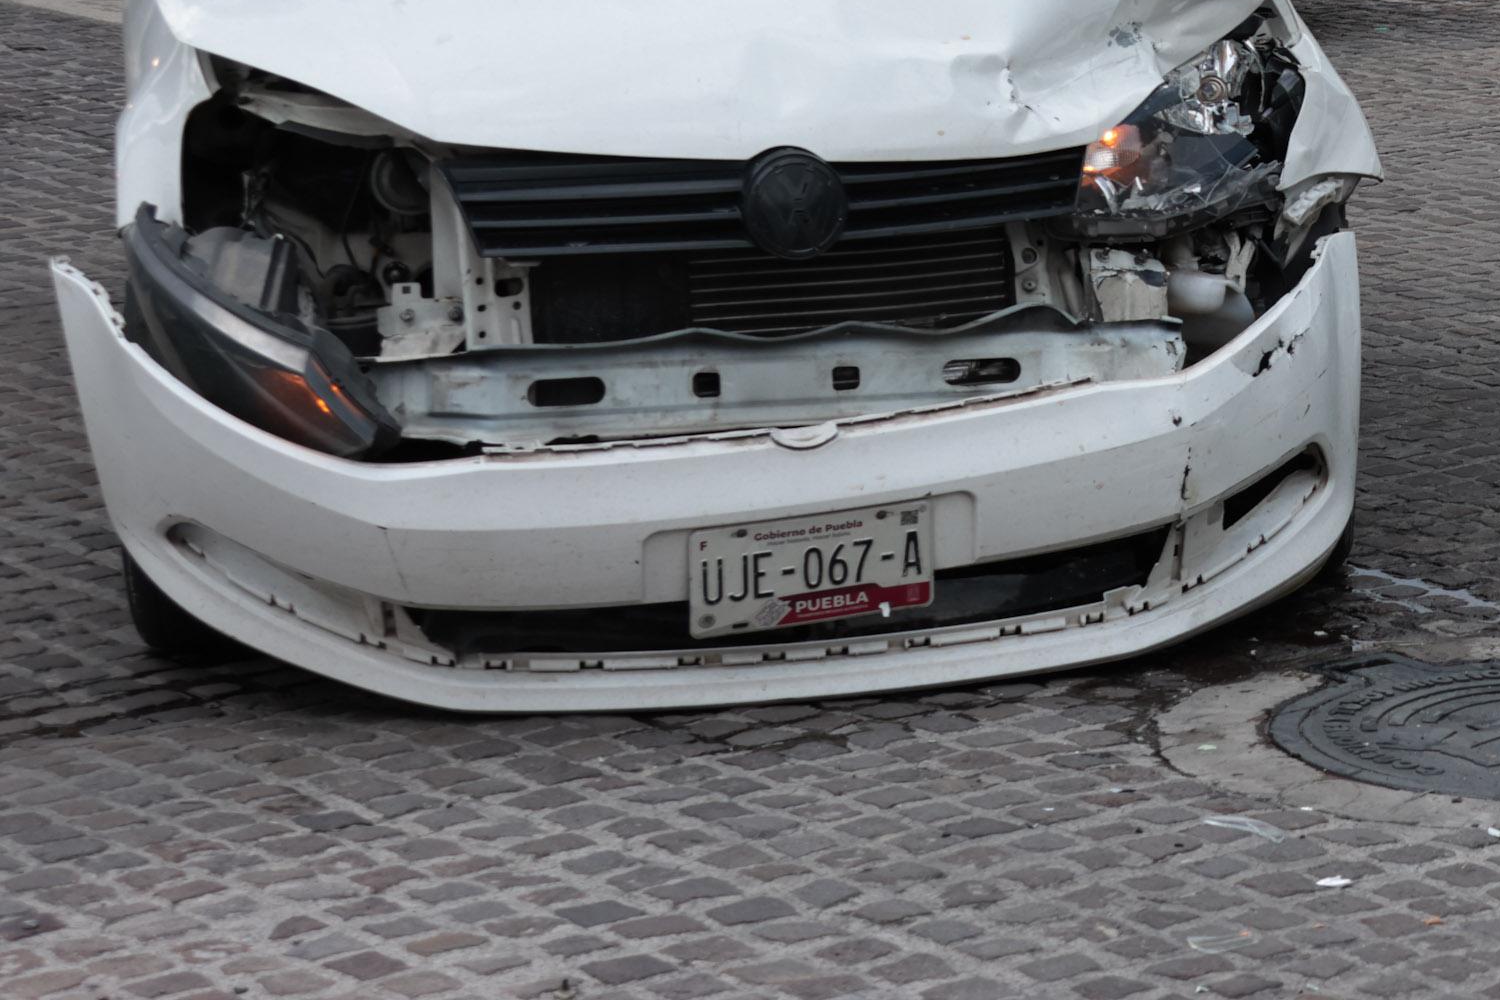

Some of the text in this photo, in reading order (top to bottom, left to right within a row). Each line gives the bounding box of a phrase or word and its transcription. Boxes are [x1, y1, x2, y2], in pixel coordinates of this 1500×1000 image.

[753, 519, 864, 541] Gobierno de Puebla
[699, 541, 708, 551] F
[702, 530, 923, 606] UJE-067-A
[794, 591, 869, 613] PUEBLA
